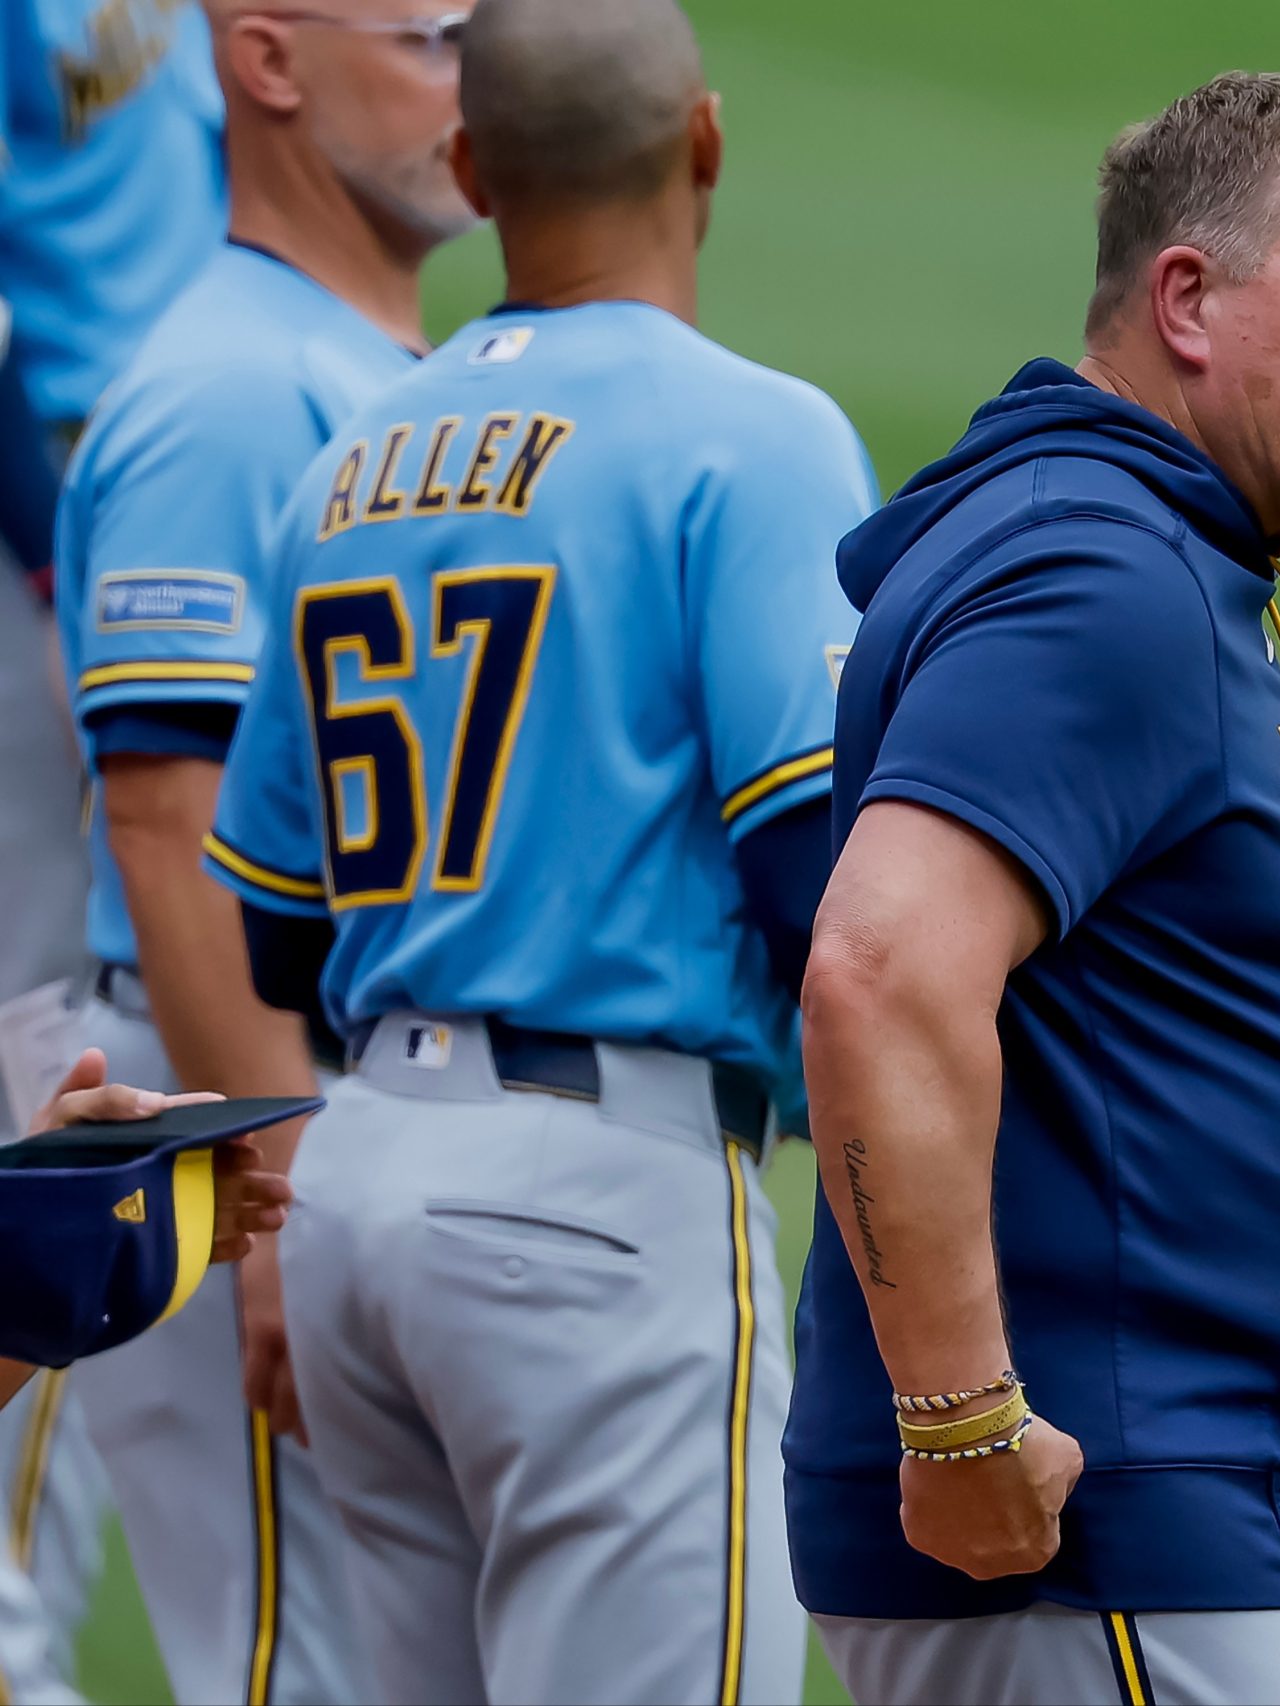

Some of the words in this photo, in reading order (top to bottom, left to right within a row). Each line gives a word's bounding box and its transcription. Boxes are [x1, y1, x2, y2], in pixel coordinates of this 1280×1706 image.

[316, 411, 575, 543] ALLEN
[293, 564, 558, 913] 67
[842, 1138, 898, 1289] Undaunted
